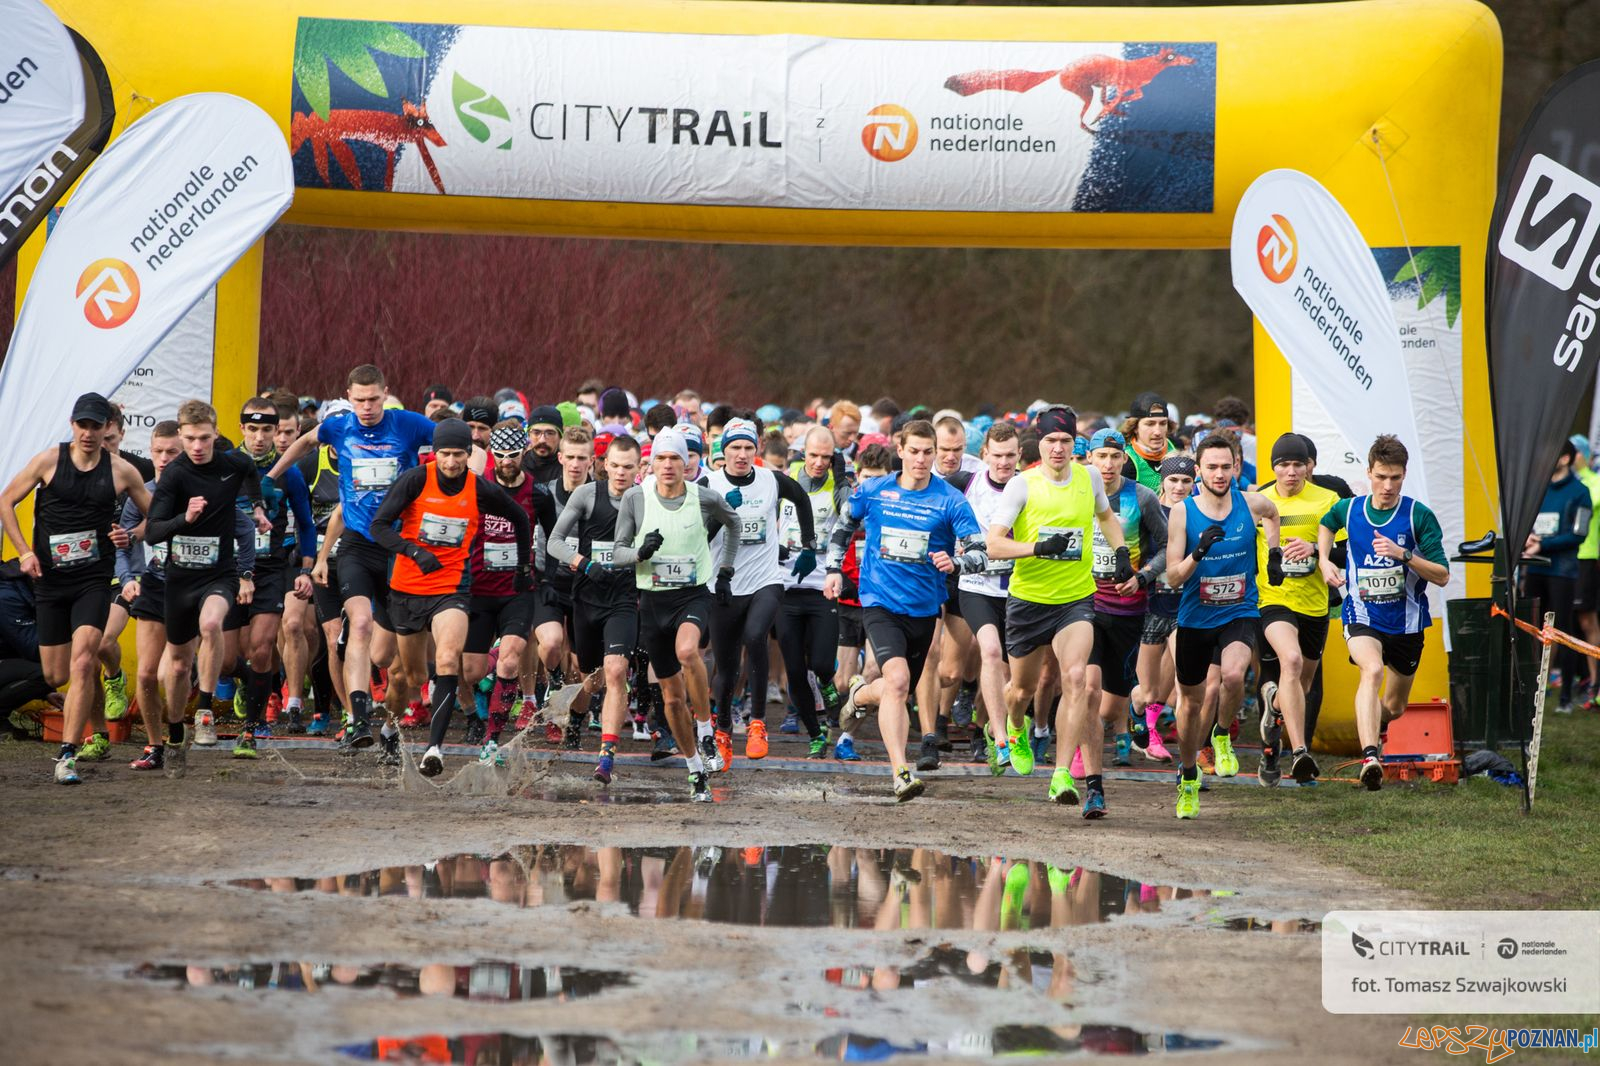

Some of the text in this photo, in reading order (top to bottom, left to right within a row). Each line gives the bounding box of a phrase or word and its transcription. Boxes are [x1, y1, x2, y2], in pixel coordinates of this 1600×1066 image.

[930, 114, 1023, 131] nationale
[930, 135, 1056, 153] nederlanden
[130, 165, 214, 253] nationale
[146, 155, 259, 271] nederlanden
[1303, 266, 1363, 345] nationale
[1294, 285, 1373, 391] nederlanden
[439, 525, 448, 535] 3
[181, 544, 210, 556] 1188
[900, 539, 908, 549] 4
[502, 551, 509, 560] 5
[666, 564, 681, 575] 14
[1366, 576, 1397, 588] 1070
[1213, 583, 1236, 594] 572
